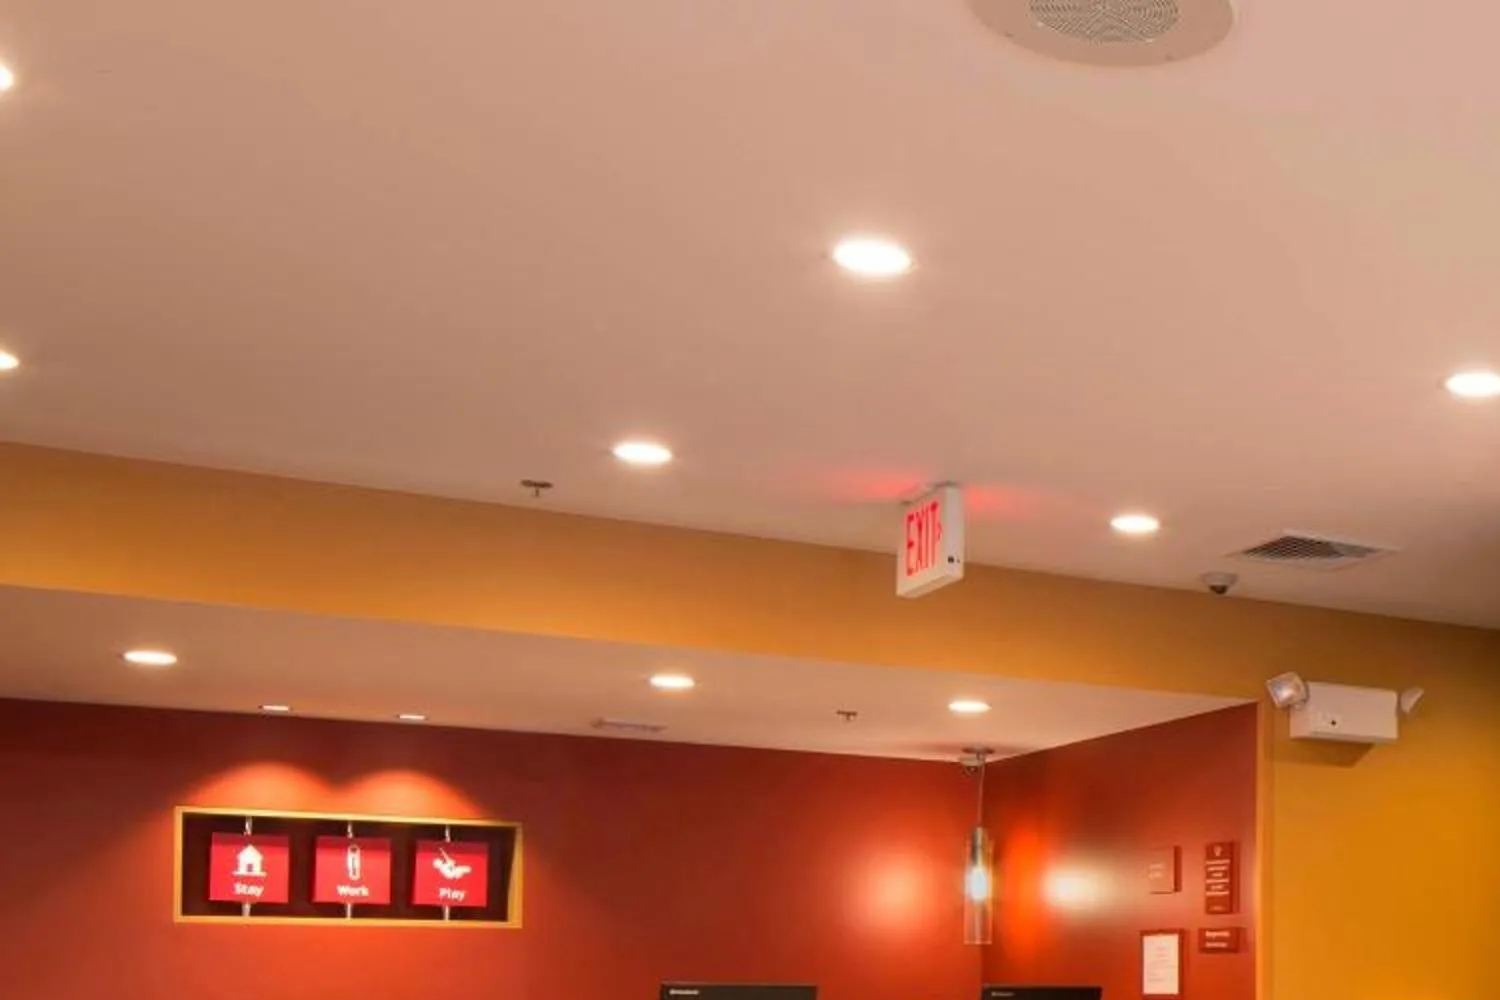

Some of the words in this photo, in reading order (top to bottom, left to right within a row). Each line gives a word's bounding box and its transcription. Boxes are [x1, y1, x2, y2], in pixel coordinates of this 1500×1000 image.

[906, 500, 940, 577] EXIT
[233, 882, 264, 897] Stay
[336, 884, 369, 897] Work
[439, 888, 466, 901] Play
